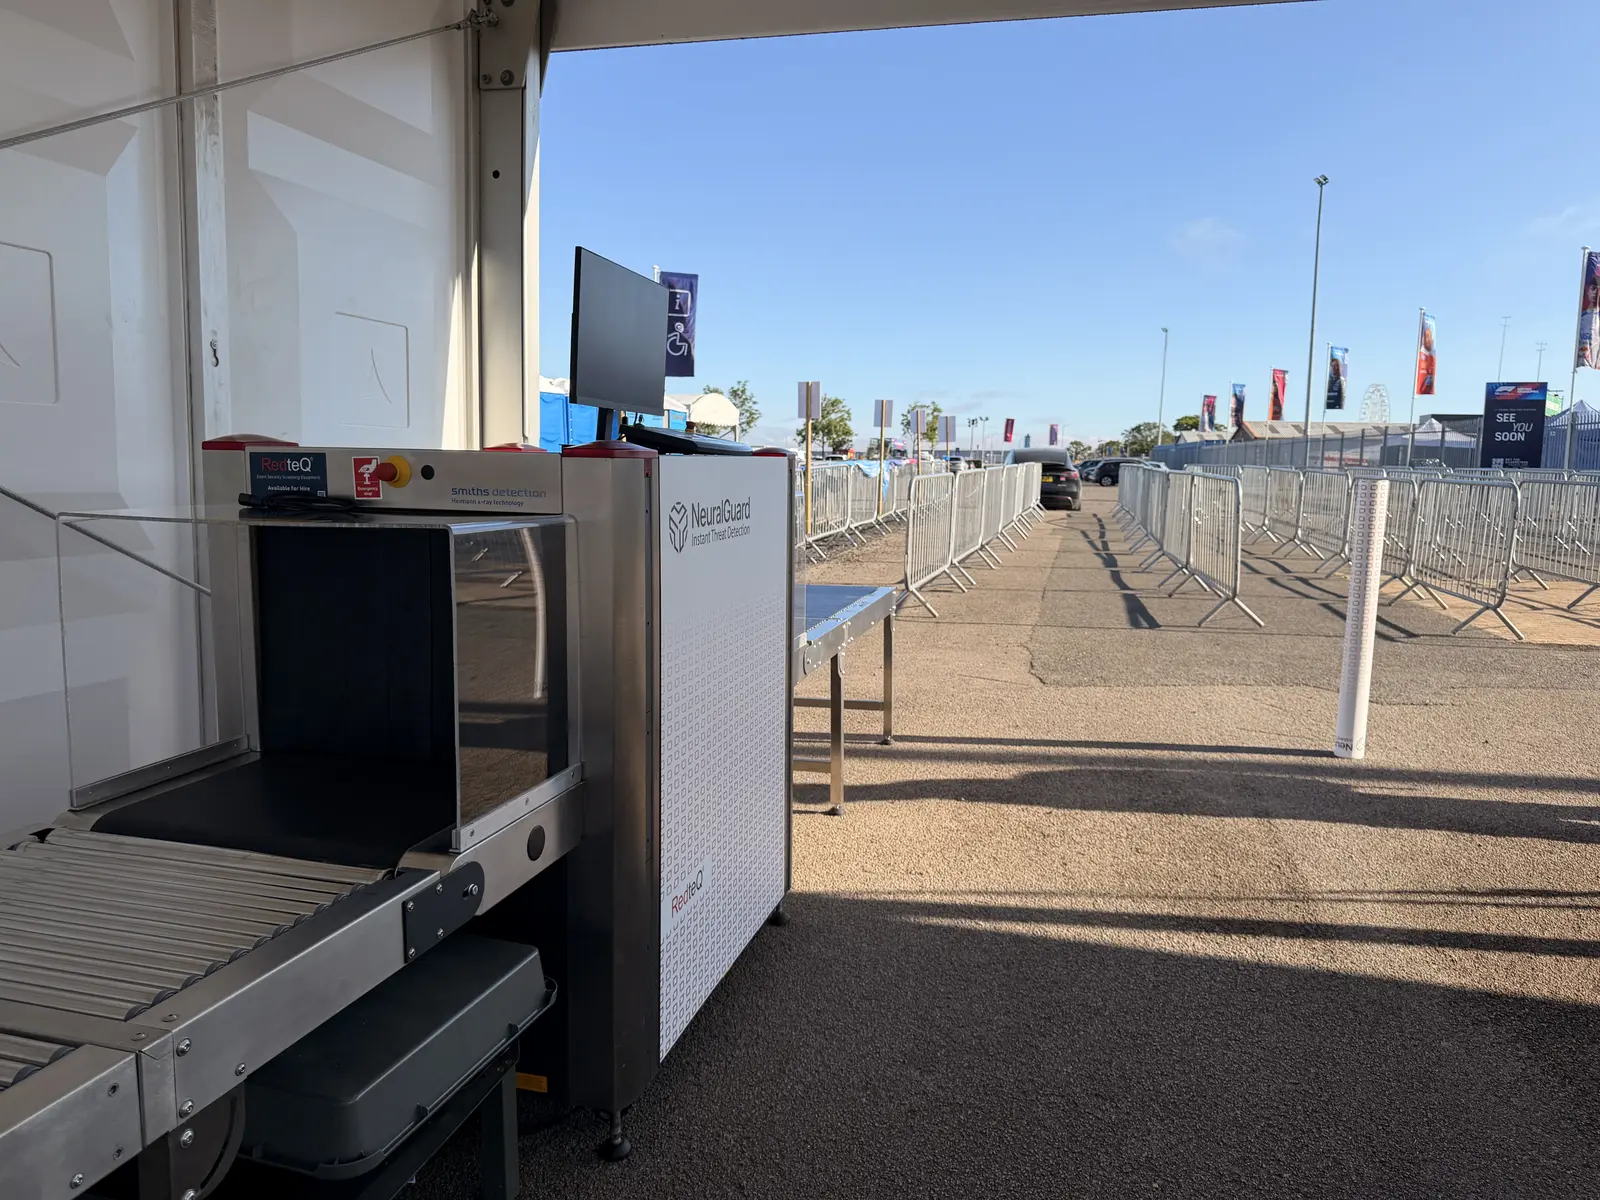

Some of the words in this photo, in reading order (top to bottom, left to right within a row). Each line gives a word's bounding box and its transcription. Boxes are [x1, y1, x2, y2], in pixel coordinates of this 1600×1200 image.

[1496, 413, 1516, 422] SEE
[1512, 423, 1533, 432] YOU
[1494, 432, 1525, 442] SOON
[451, 487, 490, 496] smiths
[492, 488, 547, 498] detection
[691, 496, 751, 528] NeuralGuard
[692, 530, 711, 547] Instant
[711, 527, 727, 542] Threat
[727, 524, 751, 539] Detection
[671, 869, 703, 918] RedteQ
